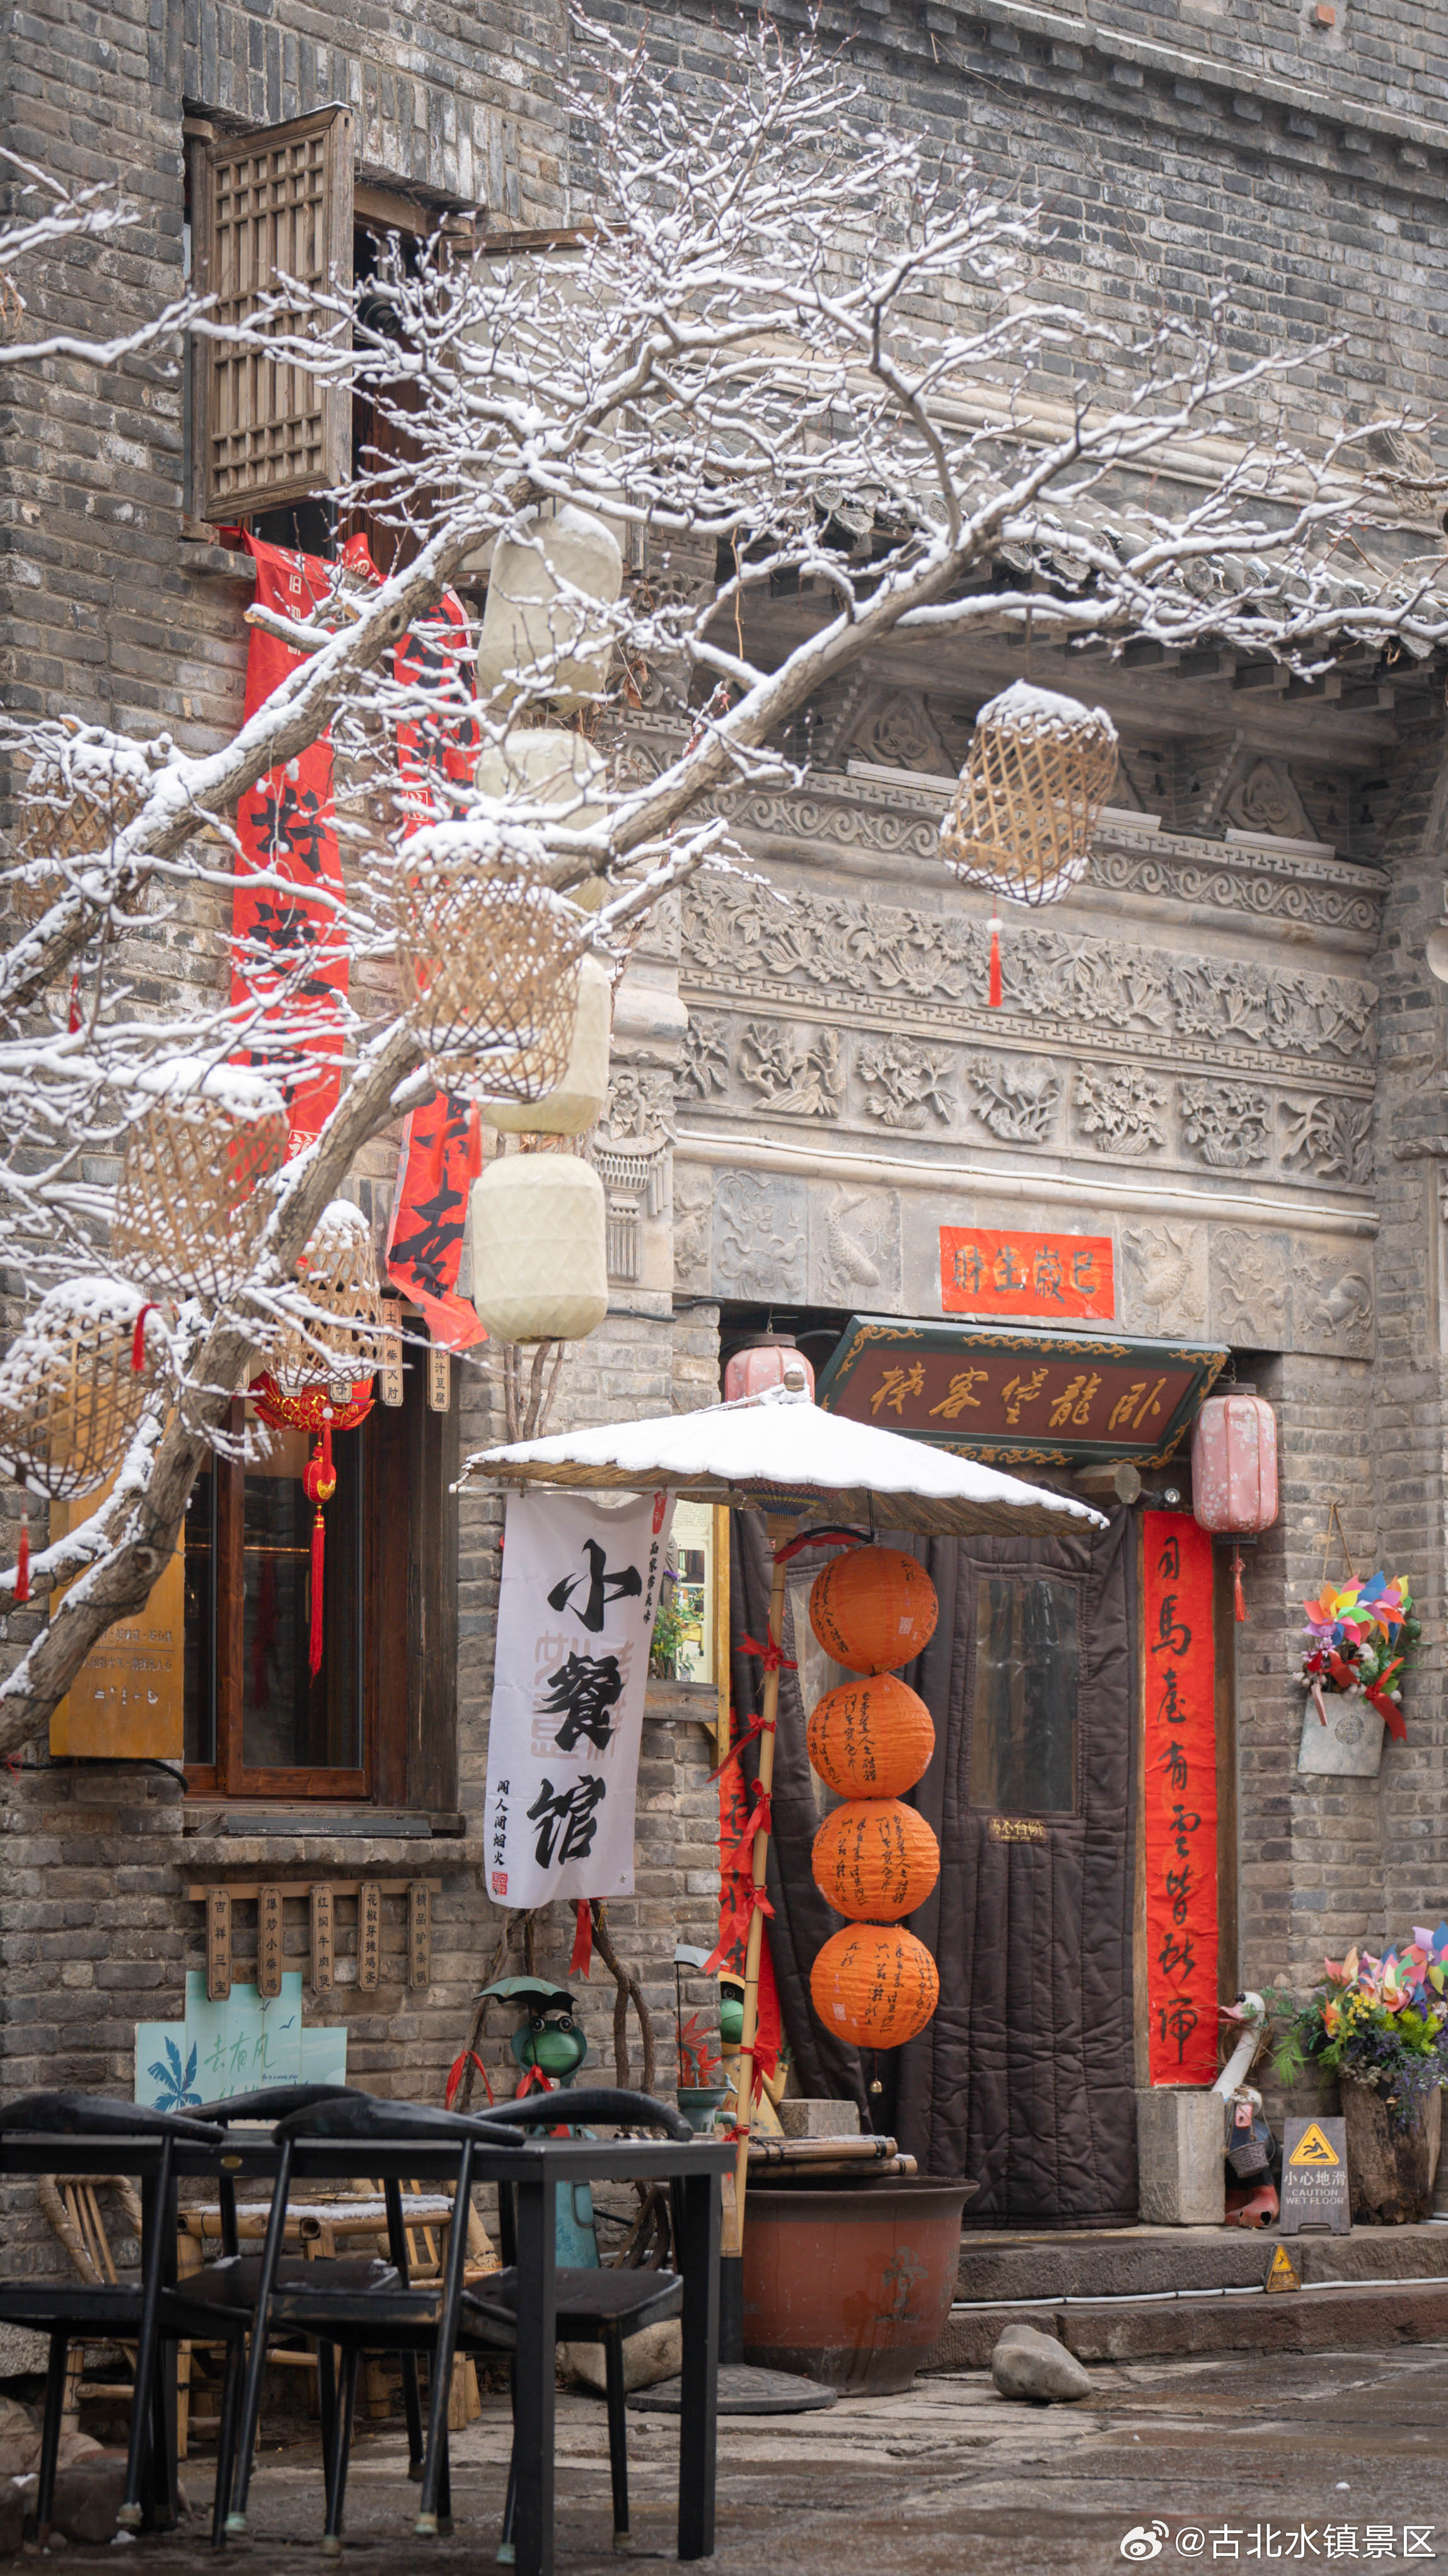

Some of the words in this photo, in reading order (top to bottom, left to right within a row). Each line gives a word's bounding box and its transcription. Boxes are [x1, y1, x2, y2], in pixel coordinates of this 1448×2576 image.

[526, 1538, 643, 1869] 小餐馆
[214, 1901, 226, 1993] 吉祥三宝
[266, 1898, 277, 1990] 爆炒小柴鸡
[204, 2031, 277, 2075] 去有风
[1283, 2171, 1346, 2186] 小心地滑
